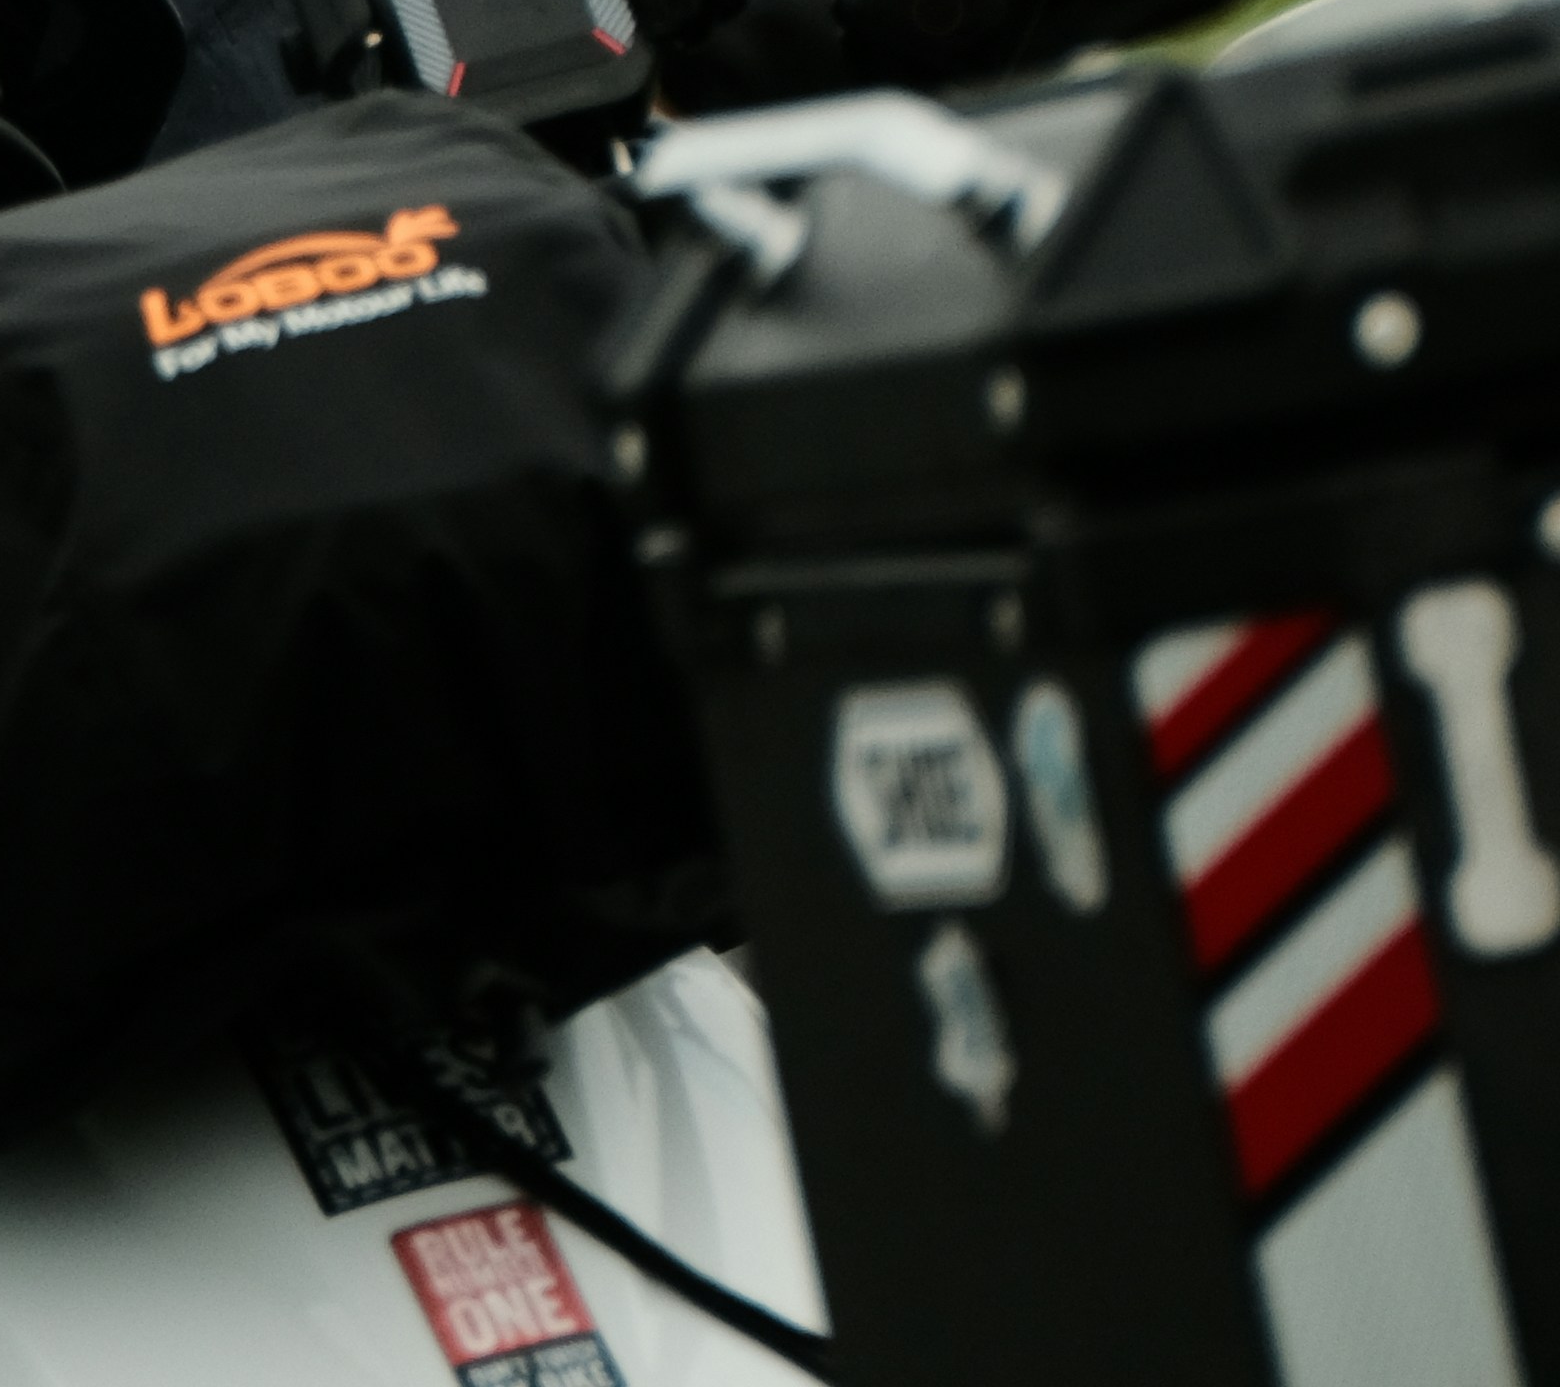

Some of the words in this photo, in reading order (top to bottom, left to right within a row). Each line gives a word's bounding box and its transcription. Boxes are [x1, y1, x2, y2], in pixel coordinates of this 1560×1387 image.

[153, 334, 219, 382] For
[219, 316, 279, 353] My
[410, 1207, 540, 1281] RULE
[446, 1276, 578, 1354] ONE
